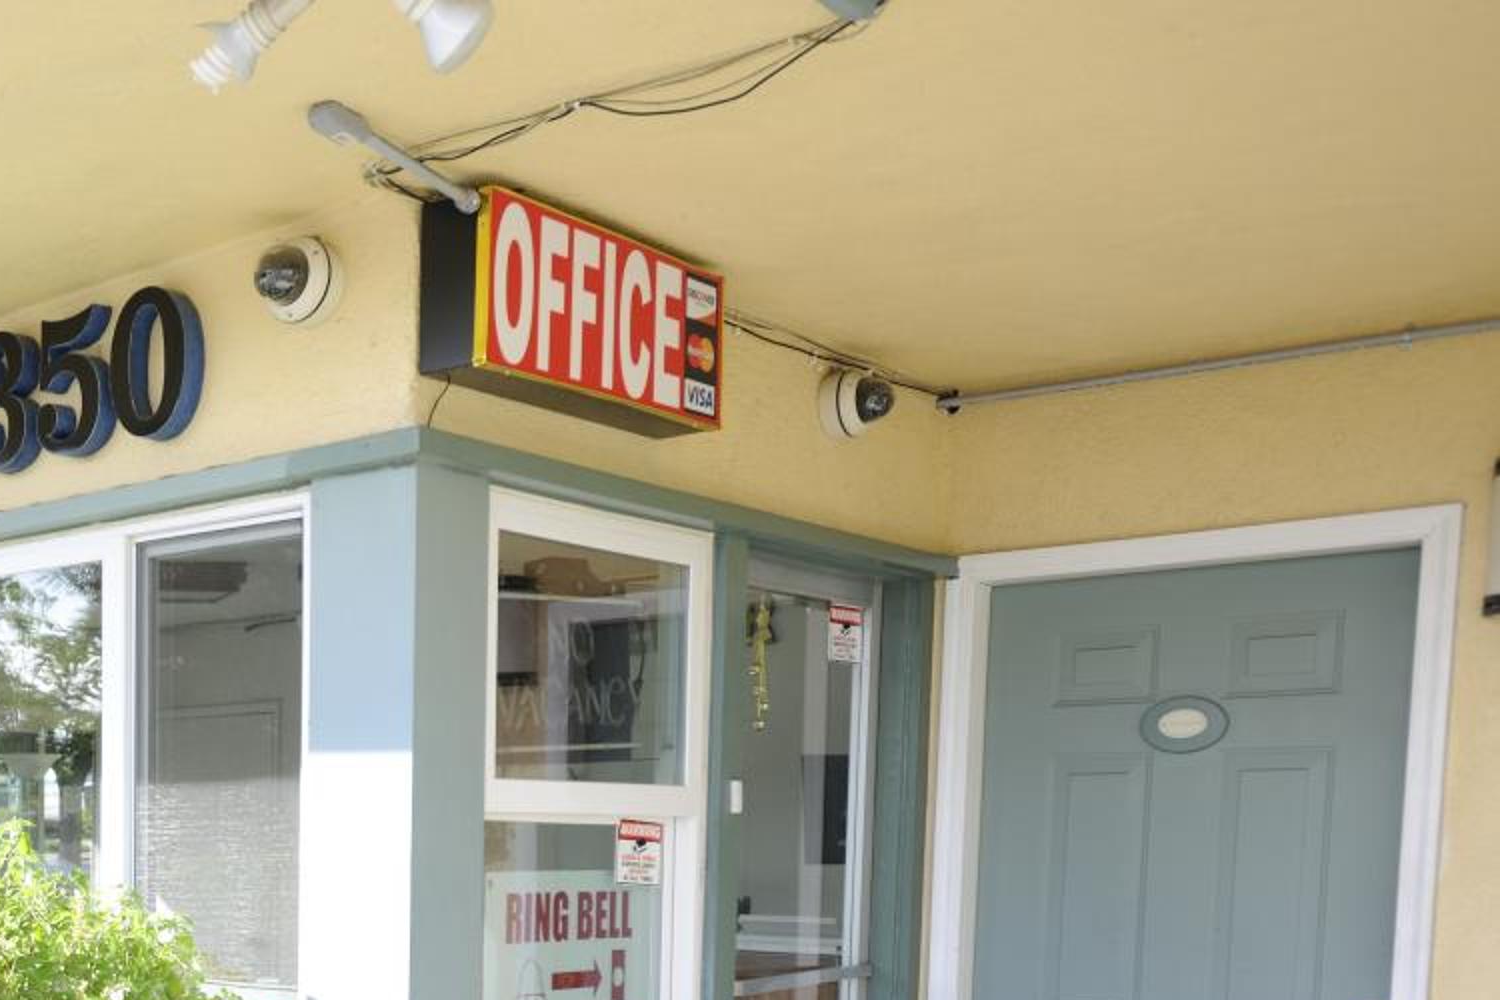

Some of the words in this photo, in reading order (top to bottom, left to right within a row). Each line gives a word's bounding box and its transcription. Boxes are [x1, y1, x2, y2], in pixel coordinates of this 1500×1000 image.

[493, 201, 685, 410] OFFICE
[687, 383, 713, 408] VISA
[505, 891, 569, 944] RING
[577, 890, 632, 940] BELL
